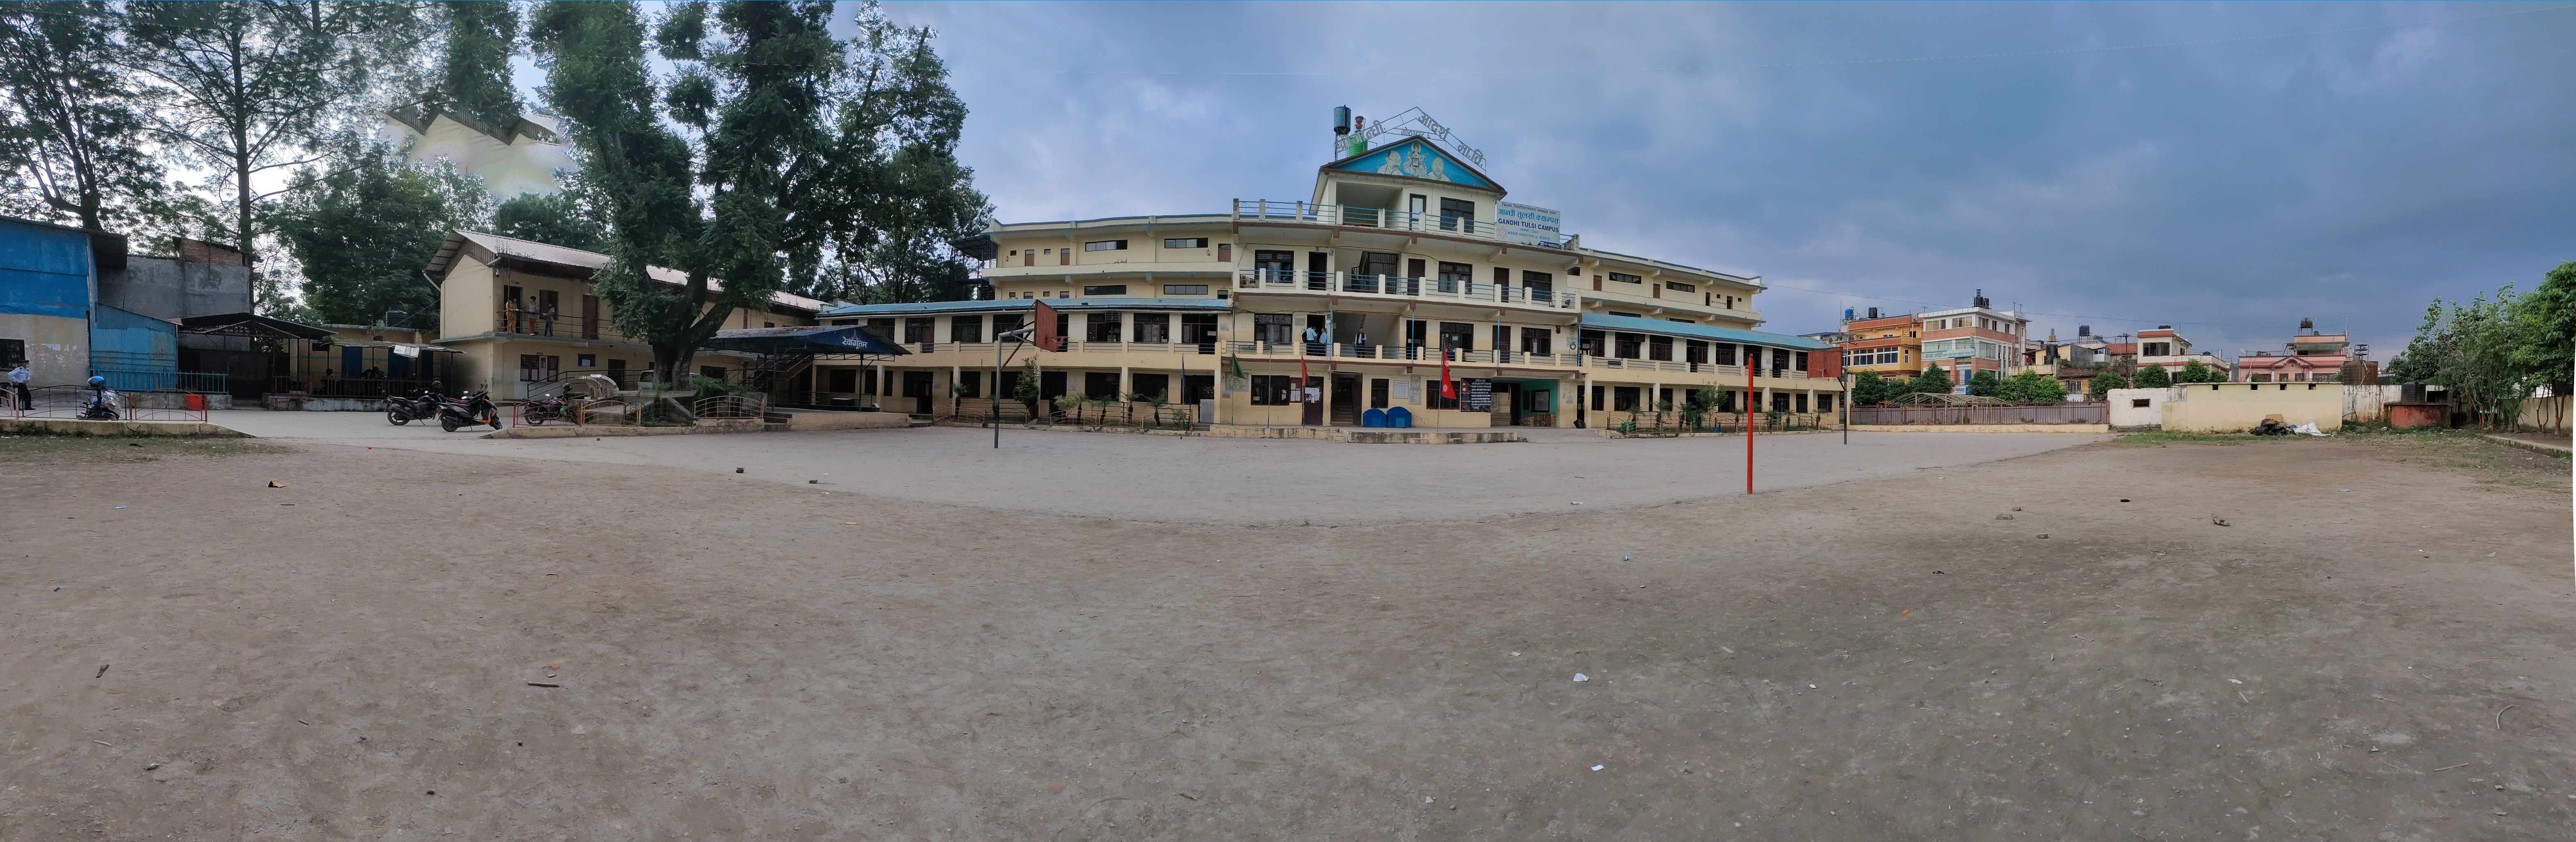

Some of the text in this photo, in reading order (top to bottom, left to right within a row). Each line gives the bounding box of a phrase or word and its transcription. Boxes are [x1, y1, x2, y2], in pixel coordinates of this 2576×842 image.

[1353, 120, 1384, 144] गान्धी
[1418, 111, 1450, 140] आदर्श
[1536, 215, 1559, 224] क्याम्पस
[1538, 224, 1559, 232] CAMPUS
